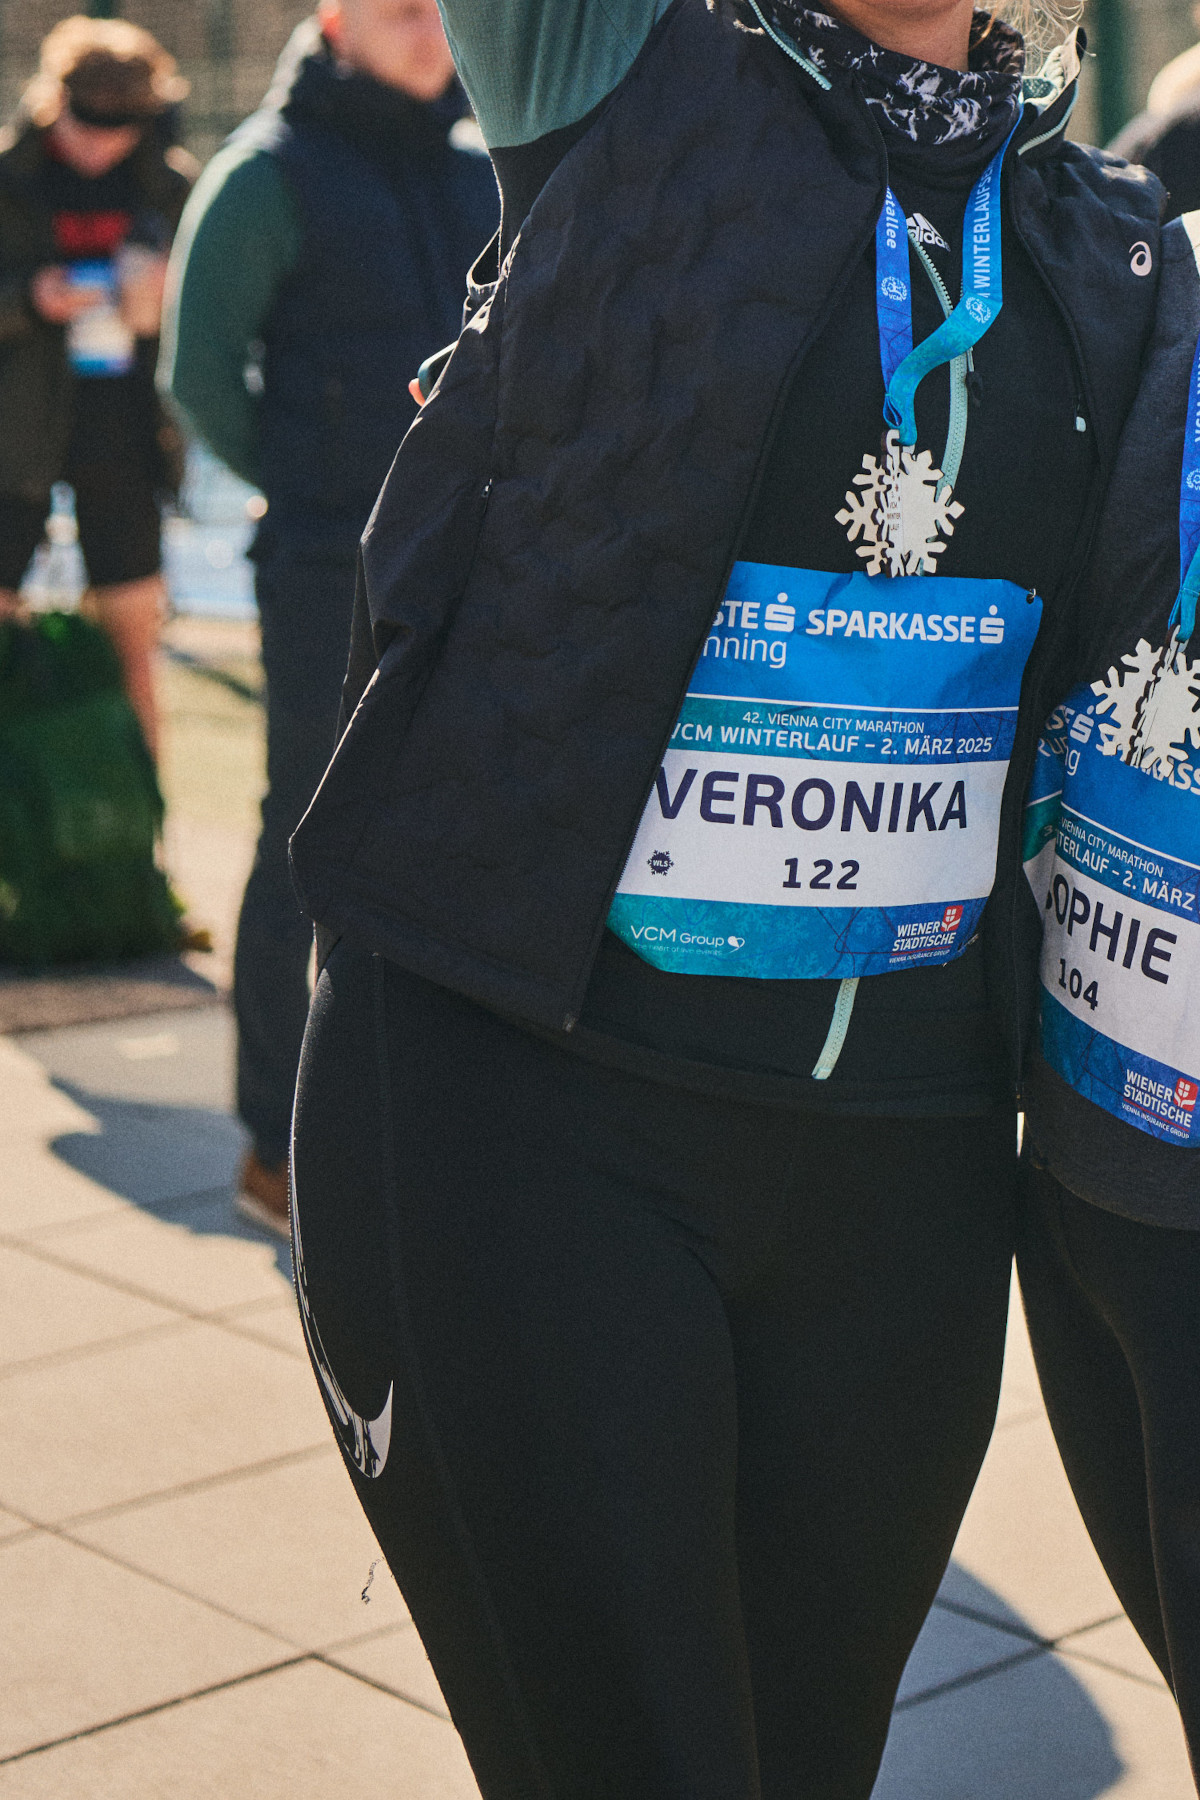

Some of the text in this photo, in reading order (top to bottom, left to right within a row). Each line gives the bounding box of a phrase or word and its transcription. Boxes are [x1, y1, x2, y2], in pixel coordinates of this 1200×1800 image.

[805, 609, 976, 643] SPARKASSE
[703, 632, 787, 669] nning
[742, 711, 925, 734] 42. VIENNA CITY MARATHON
[720, 725, 860, 753] WINTERLAUF
[880, 737, 898, 755] 2.
[904, 734, 954, 756] MÄRZ
[956, 737, 993, 754] 2025
[655, 766, 967, 833] VERONIKA
[1061, 816, 1086, 842] VIENNA
[1087, 833, 1108, 851] CITY
[1107, 843, 1164, 878] MARATHON
[782, 857, 860, 890] 122
[1122, 870, 1137, 890] 2.
[1142, 878, 1196, 911] MÄRZ
[630, 925, 676, 942] VCM
[680, 932, 725, 948] Group
[892, 932, 957, 952] STÄDTISCHE
[897, 921, 940, 937] WIENER
[1045, 873, 1178, 985] OPHIE
[1058, 958, 1099, 1011] 104
[1126, 1068, 1173, 1102] WIENER
[1121, 1102, 1190, 1139] VIENNA INSURANCE GROUP
[1123, 1084, 1193, 1128] STÄDTISCHE
